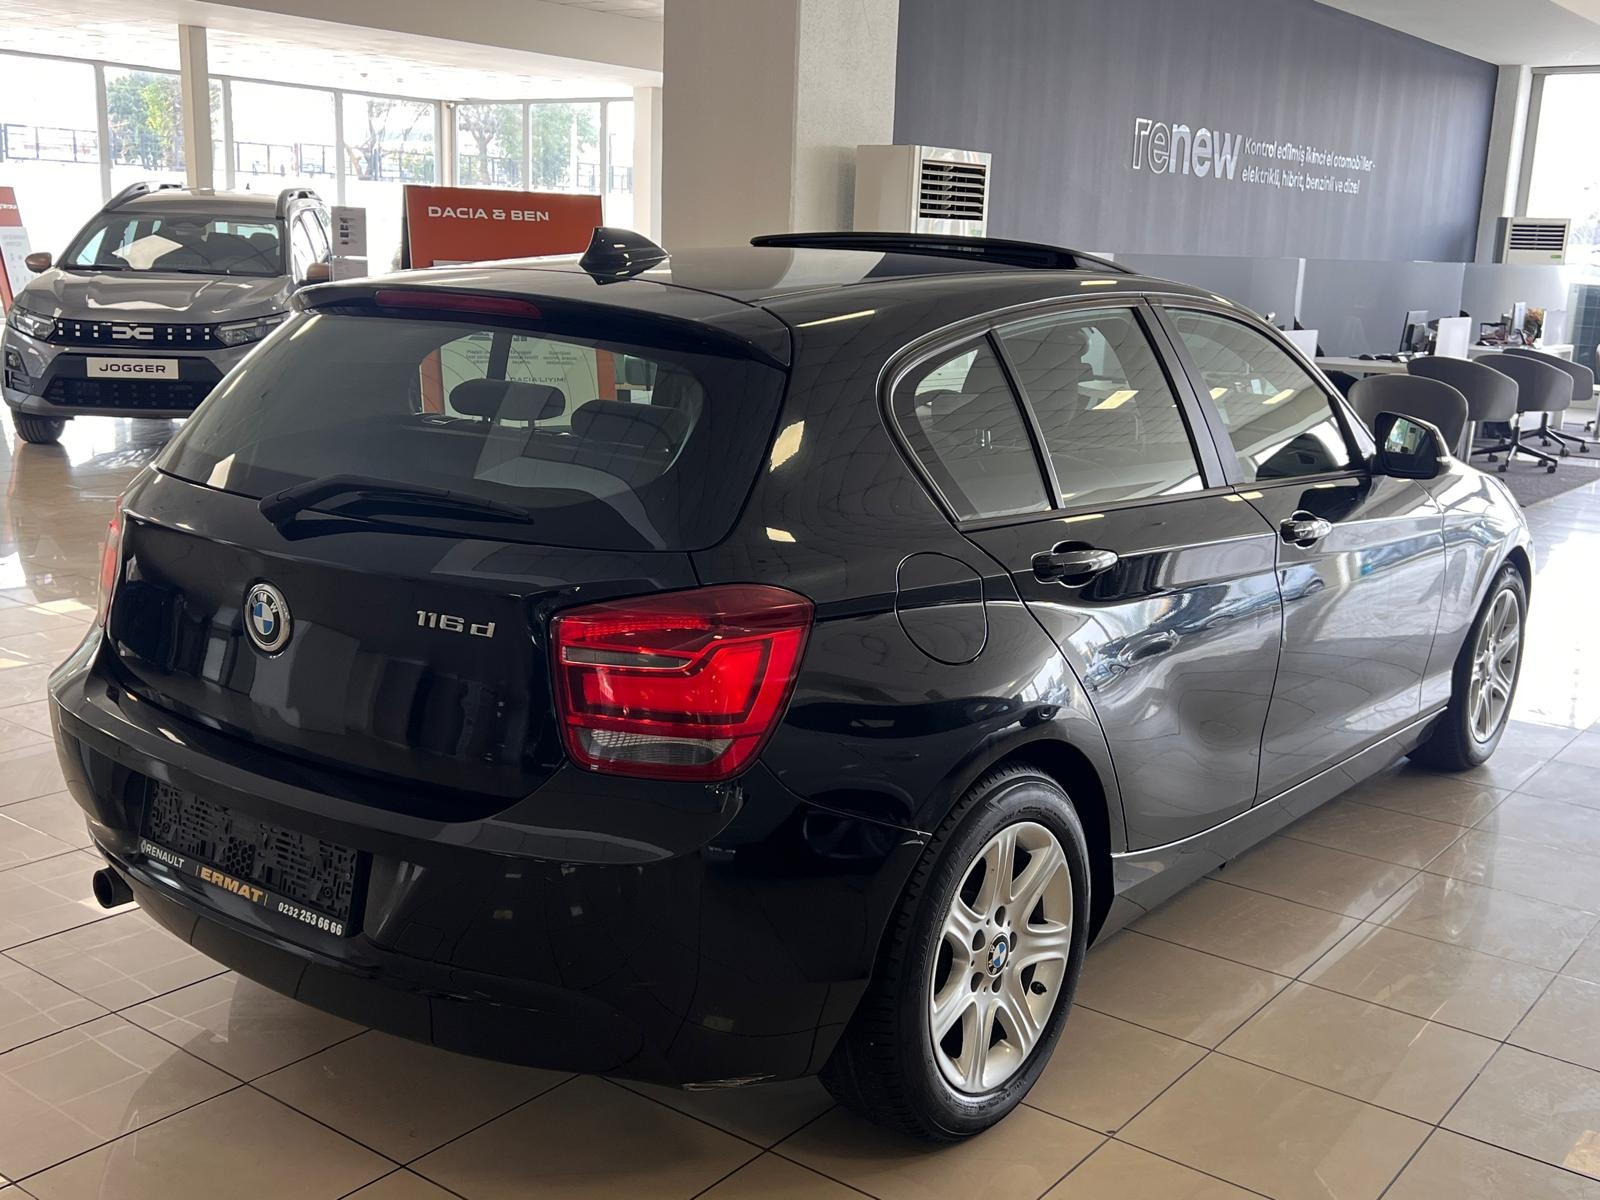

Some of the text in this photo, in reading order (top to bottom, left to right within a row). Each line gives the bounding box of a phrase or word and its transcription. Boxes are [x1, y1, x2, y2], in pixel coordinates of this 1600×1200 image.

[1132, 117, 1242, 180] renew
[1244, 137, 1277, 158] Kontrol
[1334, 180, 1343, 192] ve
[428, 206, 549, 222] DACIA & BEN
[99, 363, 166, 373] JOGGER
[146, 844, 185, 868] RENAULT
[200, 866, 263, 902] ERMAT
[278, 902, 299, 918] 0232
[299, 909, 317, 925] 253
